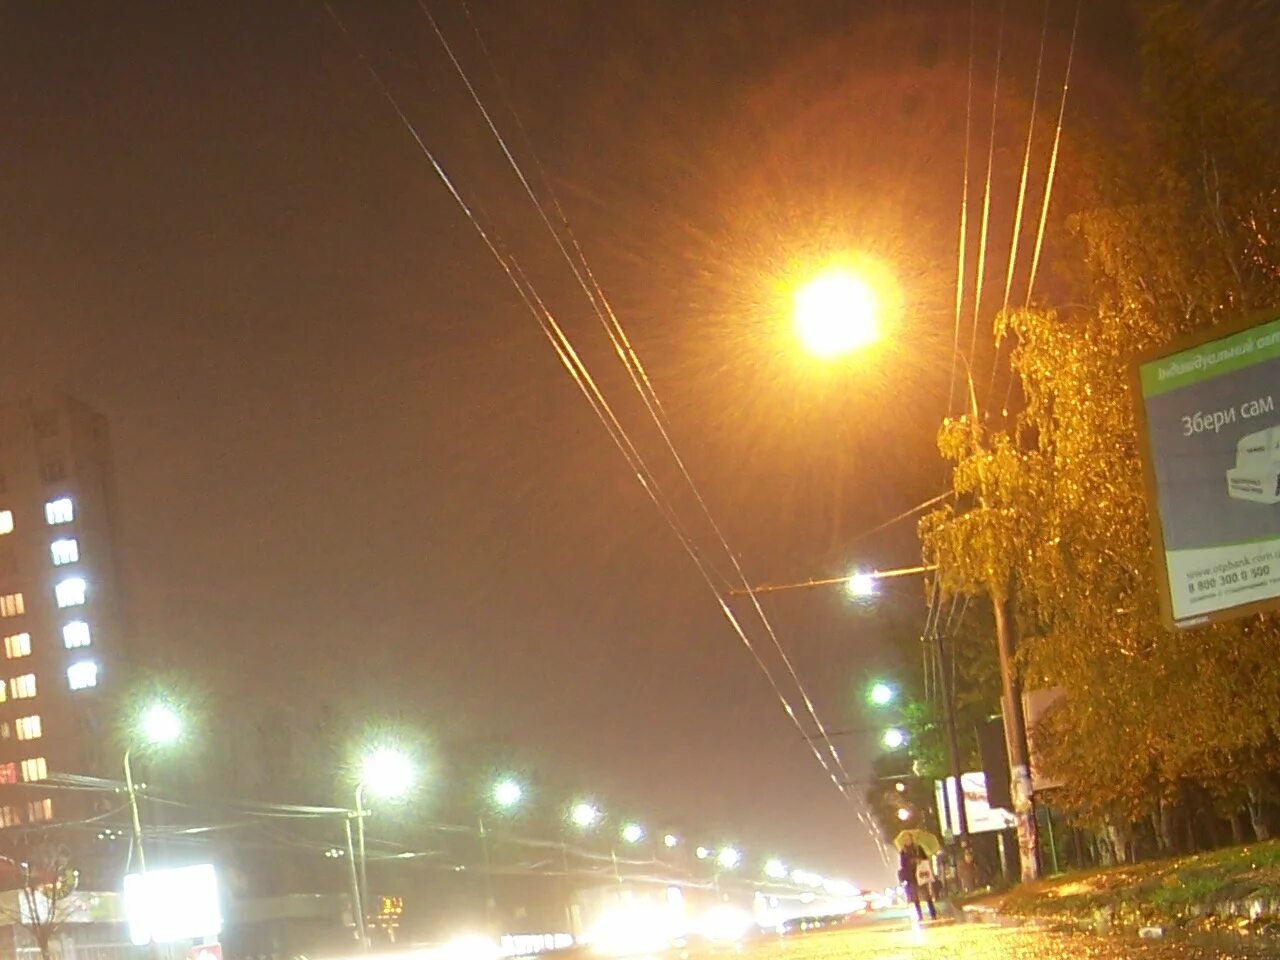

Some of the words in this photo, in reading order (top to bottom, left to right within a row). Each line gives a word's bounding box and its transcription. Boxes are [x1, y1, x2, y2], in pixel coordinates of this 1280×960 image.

[1182, 407, 1236, 437] Збери
[1240, 396, 1274, 420] сам
[1197, 577, 1216, 591] 800
[1218, 572, 1238, 586] 300
[1250, 565, 1270, 578] 500
